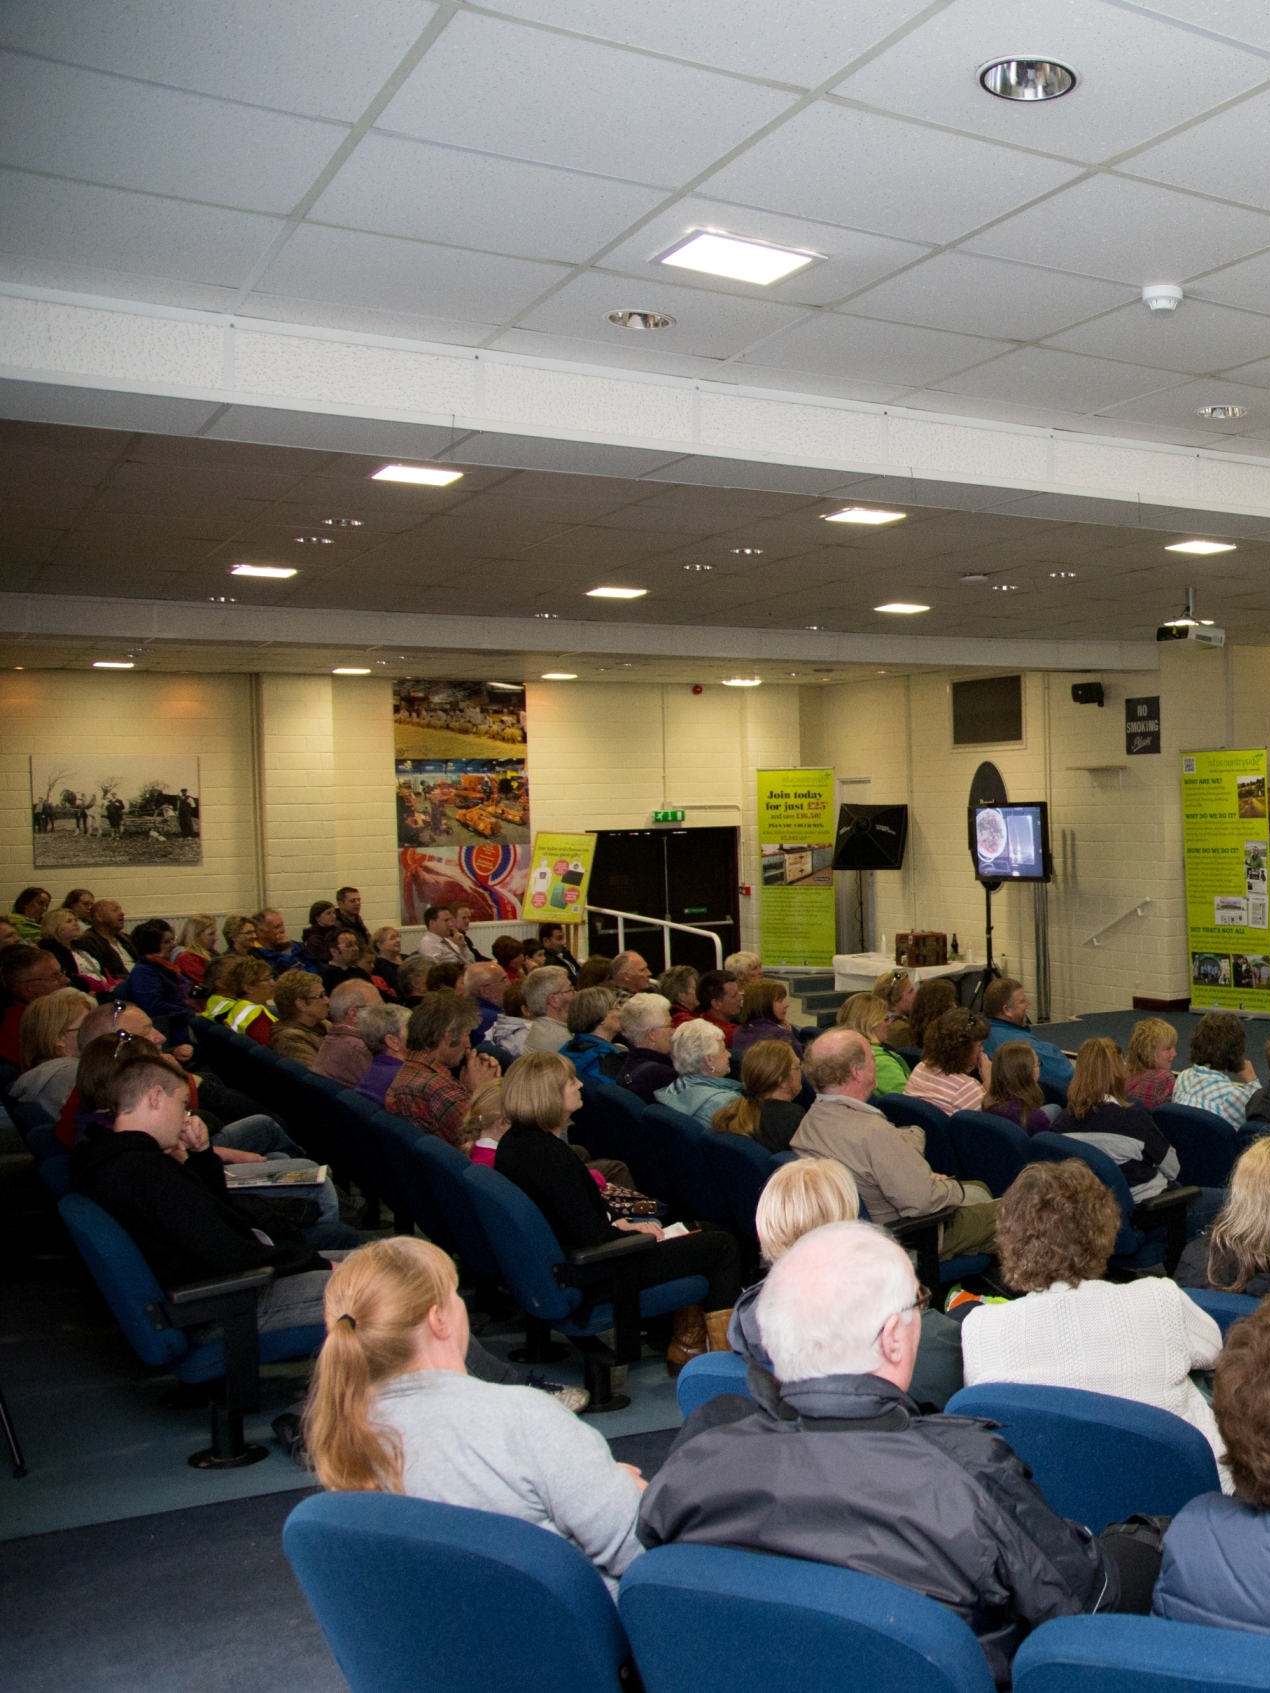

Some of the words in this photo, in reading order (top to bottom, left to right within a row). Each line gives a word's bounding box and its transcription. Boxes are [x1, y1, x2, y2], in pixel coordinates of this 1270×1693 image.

[1137, 704, 1148, 716] NO
[1126, 720, 1158, 733] SMOKING
[767, 790, 790, 799] Join
[794, 790, 822, 801] today
[766, 802, 781, 810] for
[784, 802, 803, 812] just
